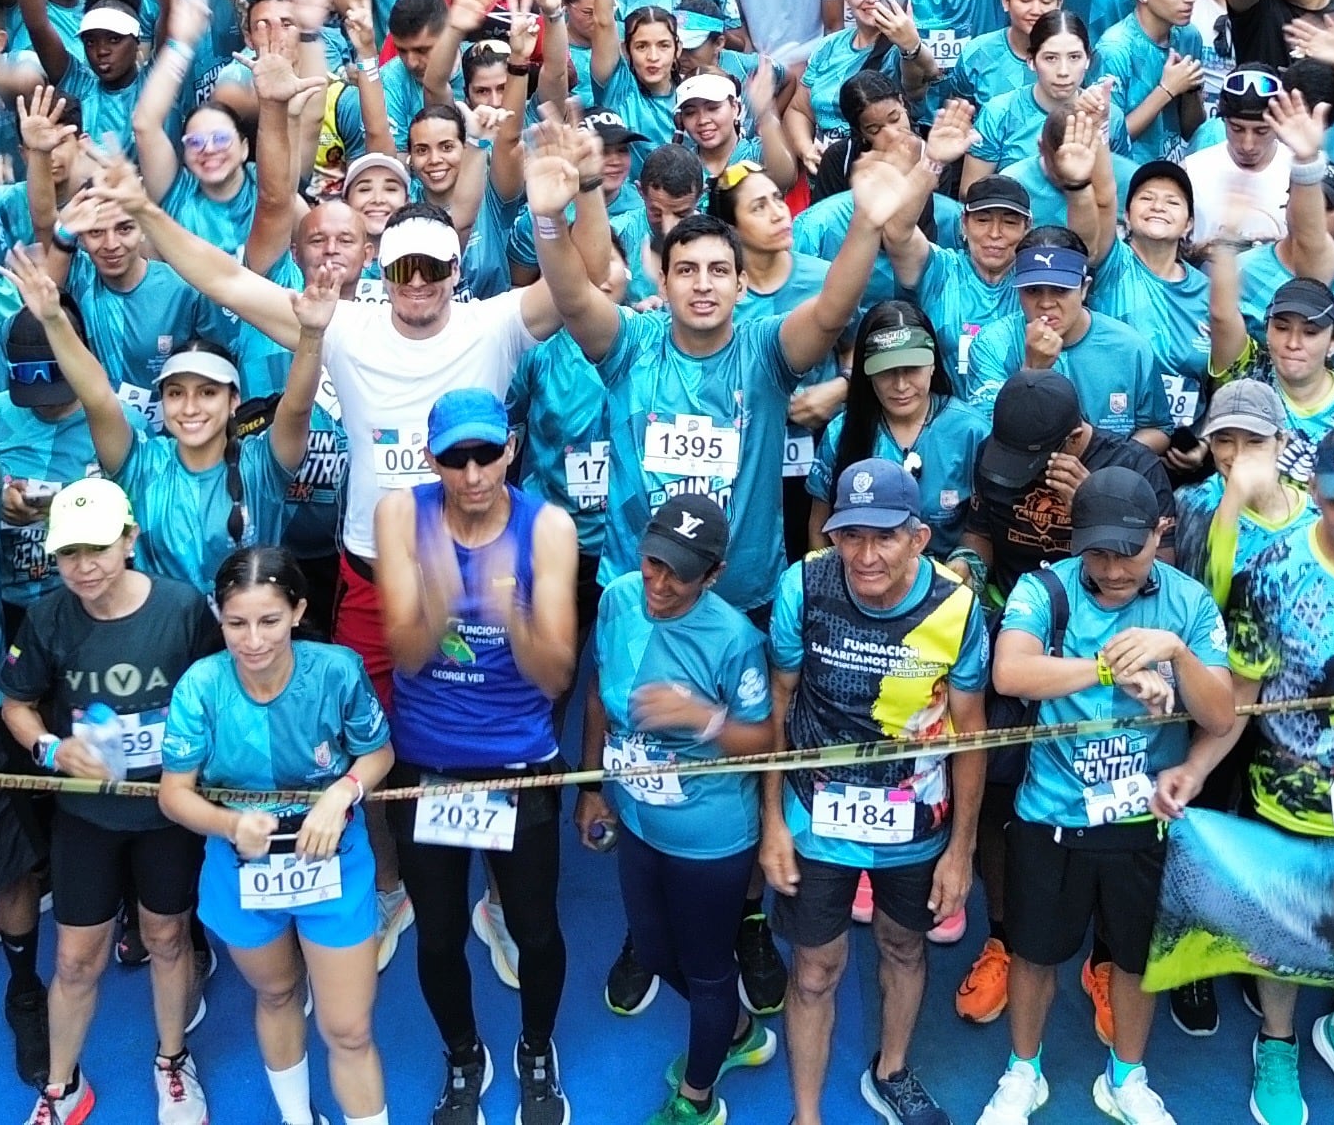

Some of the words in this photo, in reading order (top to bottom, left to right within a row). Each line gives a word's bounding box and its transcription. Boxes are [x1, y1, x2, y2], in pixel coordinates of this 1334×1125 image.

[924, 42, 962, 57] 190
[307, 431, 334, 452] UN
[659, 432, 723, 459] 1395
[300, 453, 348, 484] NTRO
[385, 449, 432, 471] 002
[577, 460, 606, 481] 17
[811, 641, 887, 668] SAMARITANOS
[65, 665, 169, 695] VIVA
[122, 730, 152, 753] 59
[1088, 735, 1127, 761] RUN
[612, 758, 664, 790] 069
[1073, 752, 1145, 784] CENTRO
[121, 783, 160, 796] ASE
[430, 804, 499, 830] 2037
[828, 801, 897, 827] 1184
[1103, 796, 1150, 823] 033
[253, 866, 322, 893] 0107
